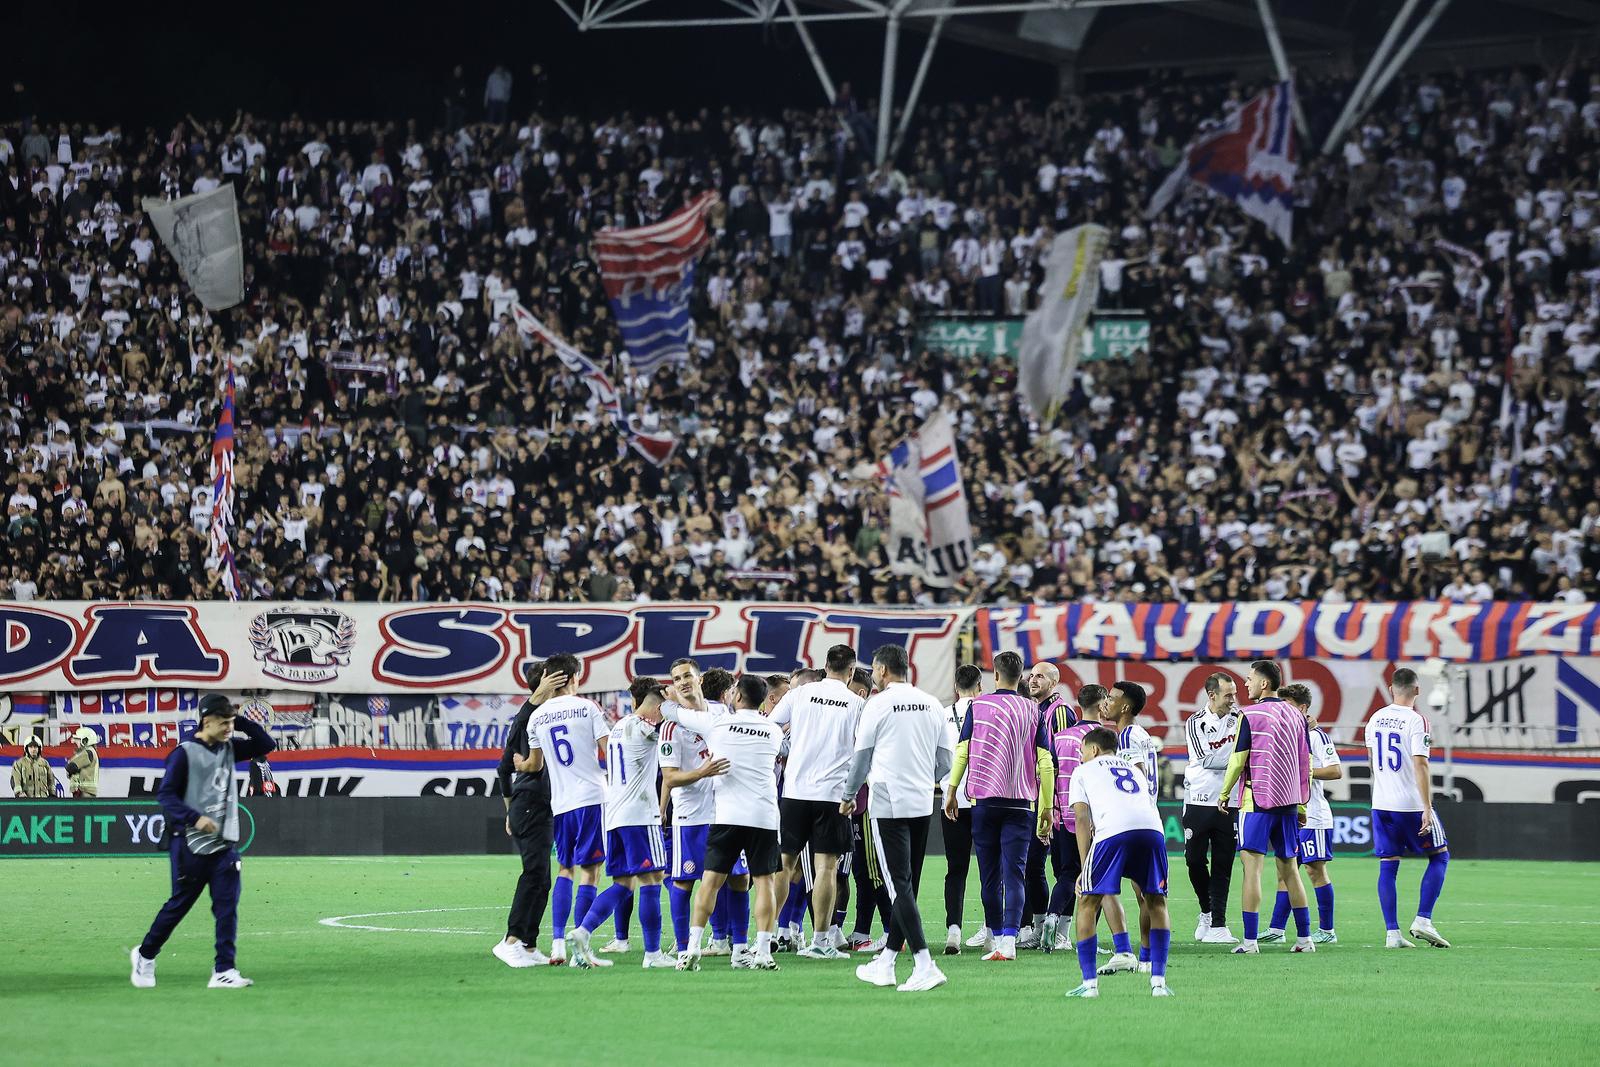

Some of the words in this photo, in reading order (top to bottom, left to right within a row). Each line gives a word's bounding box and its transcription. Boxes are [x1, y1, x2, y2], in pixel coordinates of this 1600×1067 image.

[372, 604, 957, 688] SPLIT
[988, 602, 1481, 662] HAJDUK
[1517, 603, 1600, 653] Z
[810, 696, 849, 708] HAJDUK
[549, 724, 575, 768] 6
[729, 725, 771, 739] HAJDUK
[609, 743, 627, 785] 11
[1375, 731, 1402, 772] 15
[1110, 767, 1140, 794] 8
[0, 815, 74, 844] AKE
[84, 815, 117, 844] IT
[124, 814, 166, 844] YO
[1331, 816, 1371, 844] RS
[1300, 840, 1316, 857] 16
